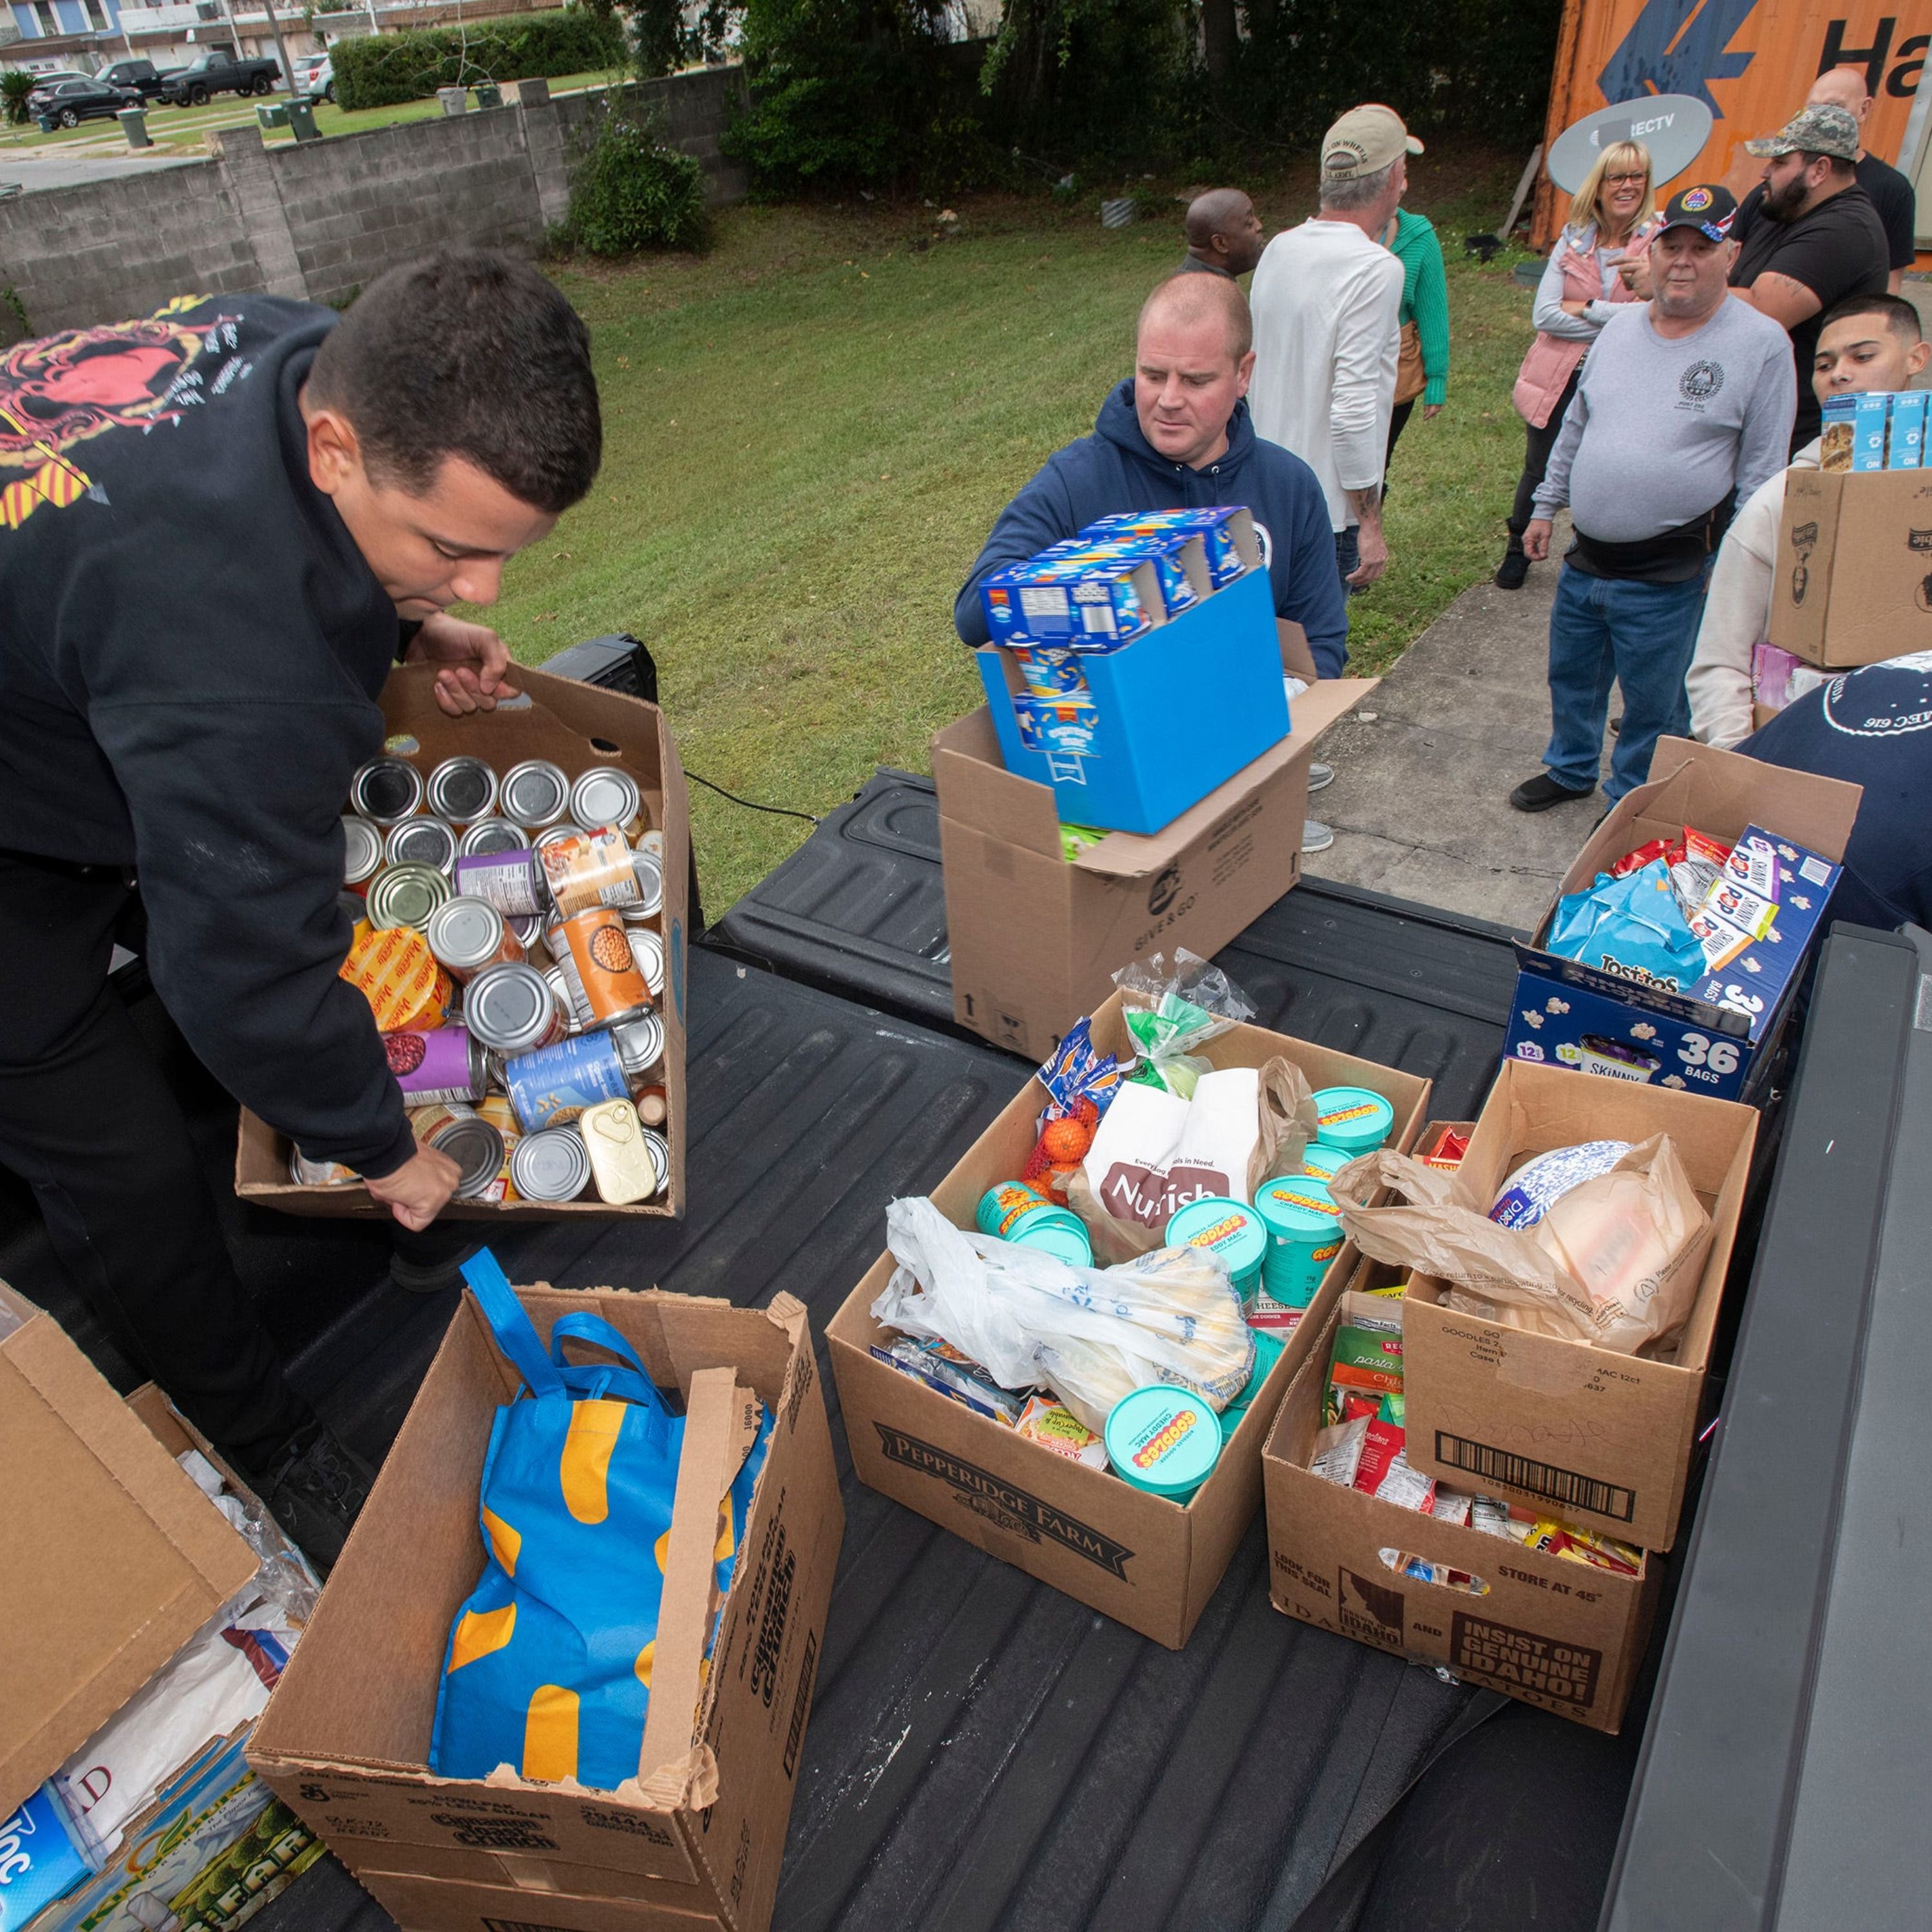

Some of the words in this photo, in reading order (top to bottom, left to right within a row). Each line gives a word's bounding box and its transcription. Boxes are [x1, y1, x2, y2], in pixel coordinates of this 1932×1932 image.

[1343, 139, 1368, 164] WHEELS
[1519, 1045, 1537, 1059] 12
[1558, 1048, 1577, 1061] 12
[1676, 1032, 1739, 1074] 36
[1683, 1065, 1720, 1085] BAGS
[1193, 1159, 1215, 1168] Need.
[1112, 1174, 1215, 1219] Nurish
[1272, 1189, 1342, 1216] GOODLES
[999, 1200, 1050, 1235] OODLES
[1189, 1215, 1243, 1247] OODLES
[1558, 1287, 1567, 1296] for
[1566, 1293, 1594, 1314] recycling.
[1442, 1326, 1491, 1345] GOODLES
[1354, 1356, 1395, 1370] pasta
[1470, 1351, 1494, 1363] Case
[1476, 1344, 1497, 1355] Item
[1620, 1373, 1640, 1384] 12ct
[744, 1404, 753, 1430] 16000
[1148, 1412, 1172, 1436] CHEDDY
[1132, 1410, 1196, 1468] GOODLES
[1135, 1434, 1151, 1448] MAC
[895, 1437, 1029, 1513] PEPPERIDGE
[1036, 1505, 1106, 1558] FARM
[1273, 1558, 1299, 1579] THIS
[1302, 1575, 1332, 1599] SEAL
[1274, 1550, 1303, 1574] LOOK
[1307, 1569, 1330, 1589] FOR
[1498, 1565, 1548, 1589] STORE
[1551, 1584, 1571, 1595] AT
[748, 1524, 788, 1694] Cinnamon
[759, 1560, 787, 1678] Toast
[759, 1546, 798, 1712] Crunch
[1341, 1613, 1400, 1646] IDAHO
[1413, 1622, 1442, 1637] AND
[1464, 1620, 1548, 1656] INSIST
[1554, 1647, 1591, 1669] ON
[1463, 1635, 1589, 1683] GENUINE
[1461, 1649, 1586, 1701] IDAHO!
[428, 1810, 545, 1835] Cinnamon
[458, 1821, 531, 1841] Toast
[147, 1797, 237, 1879] ORCHARDS
[450, 1827, 564, 1855] Crunch
